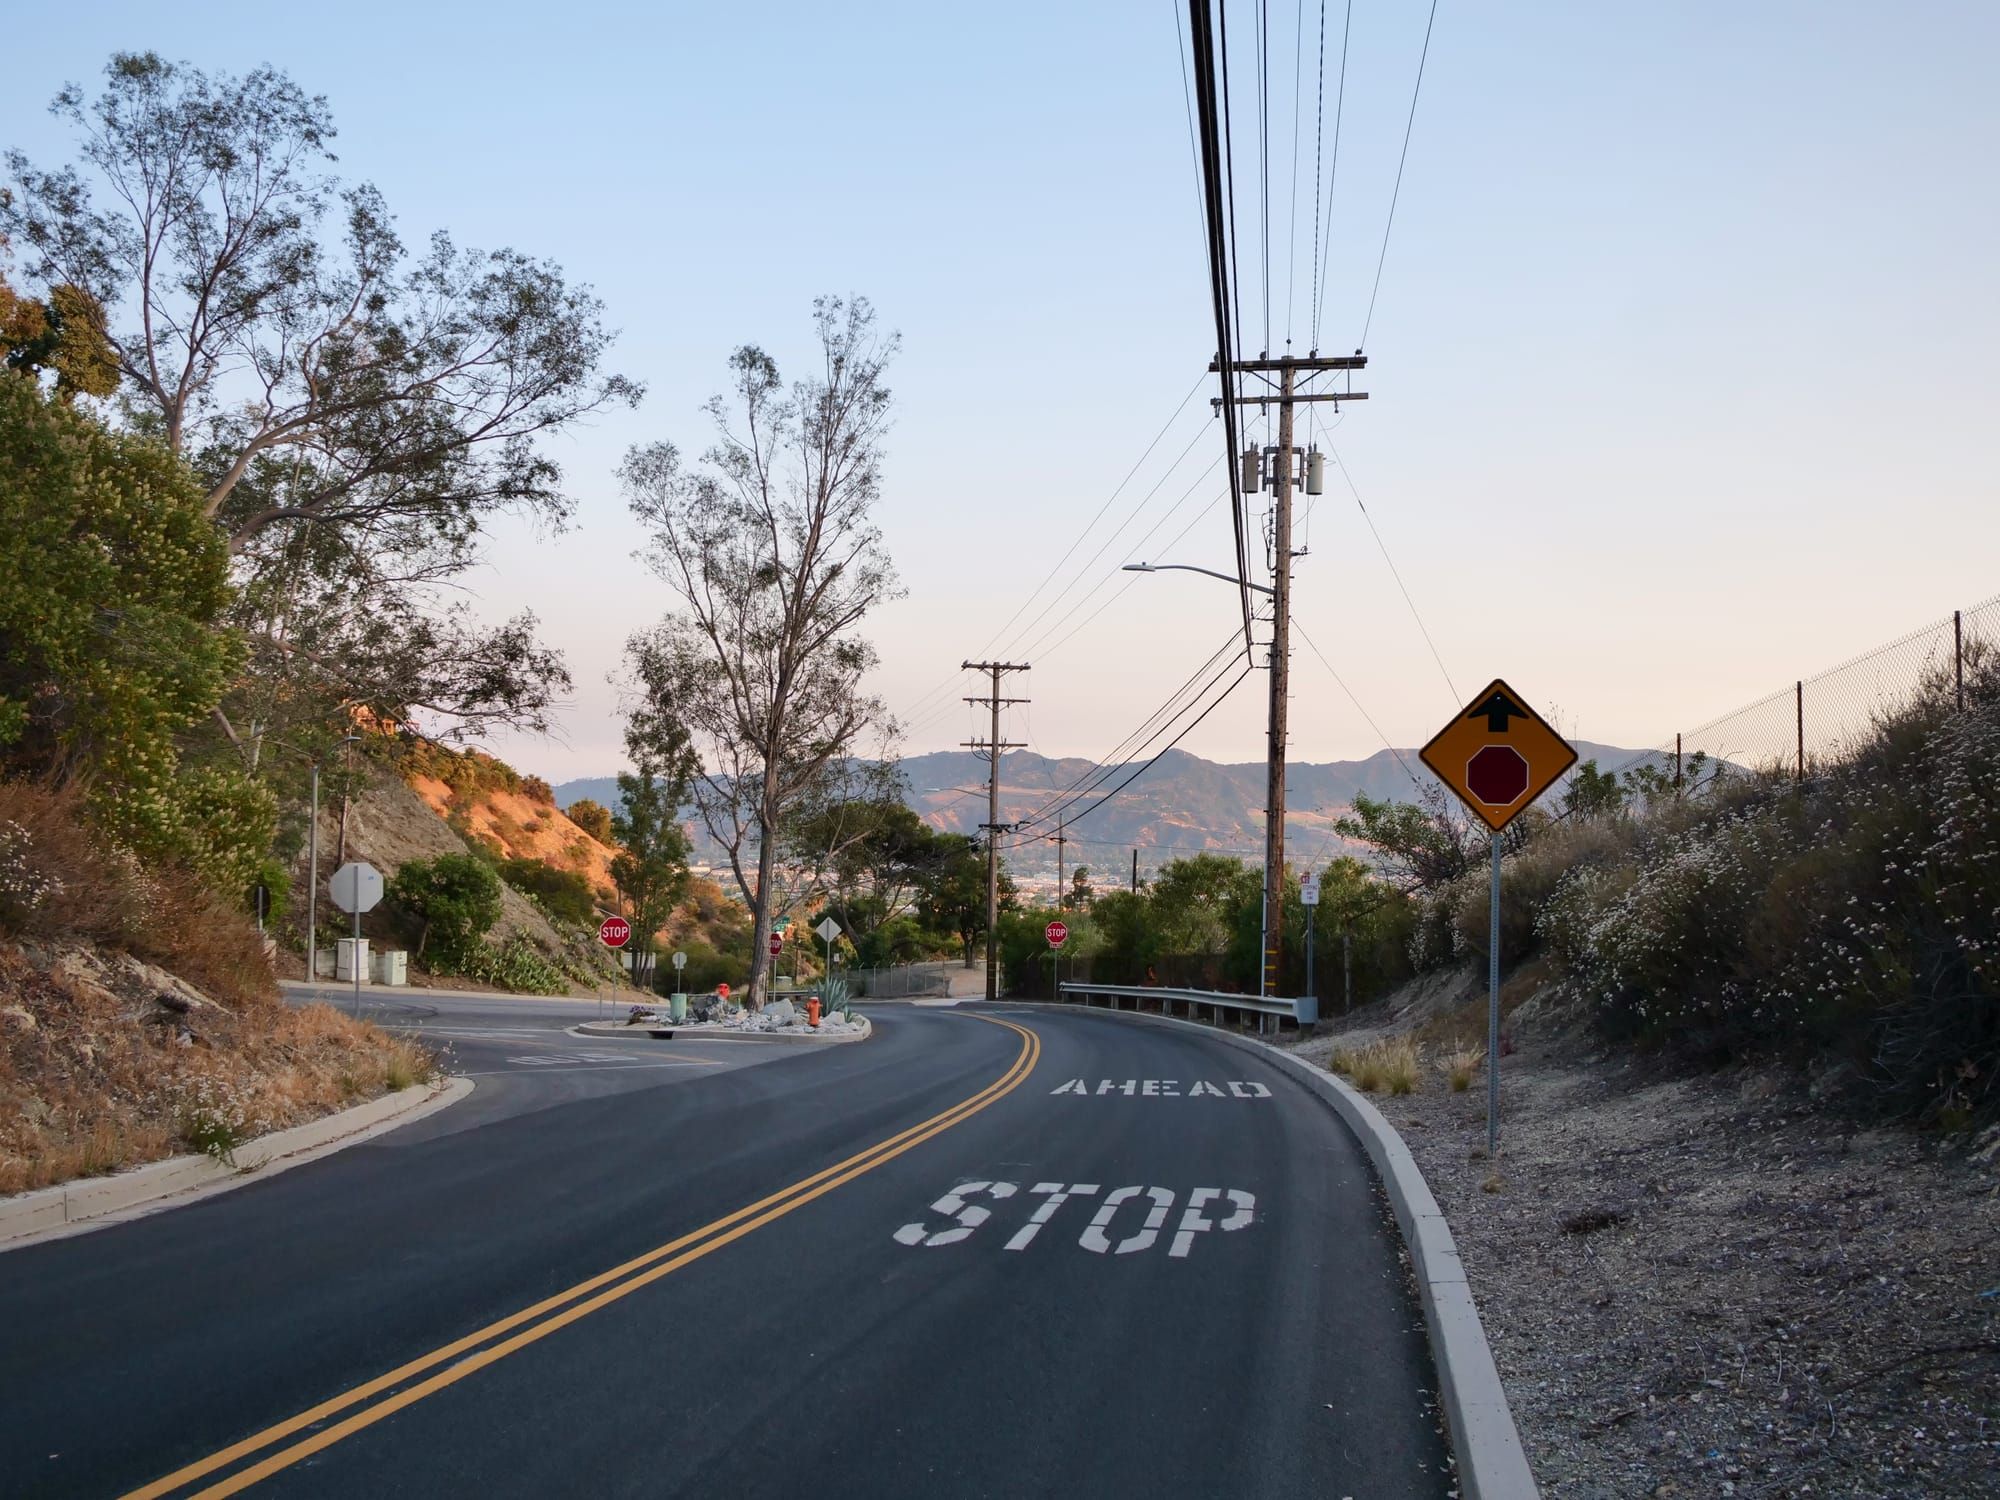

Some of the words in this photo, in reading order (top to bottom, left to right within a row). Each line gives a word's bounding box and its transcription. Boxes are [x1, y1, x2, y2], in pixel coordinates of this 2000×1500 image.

[602, 926, 628, 938] STOP
[1047, 928, 1066, 937] STOP
[1049, 1079, 1273, 1098] AHEAD
[893, 1181, 1256, 1258] STOP
